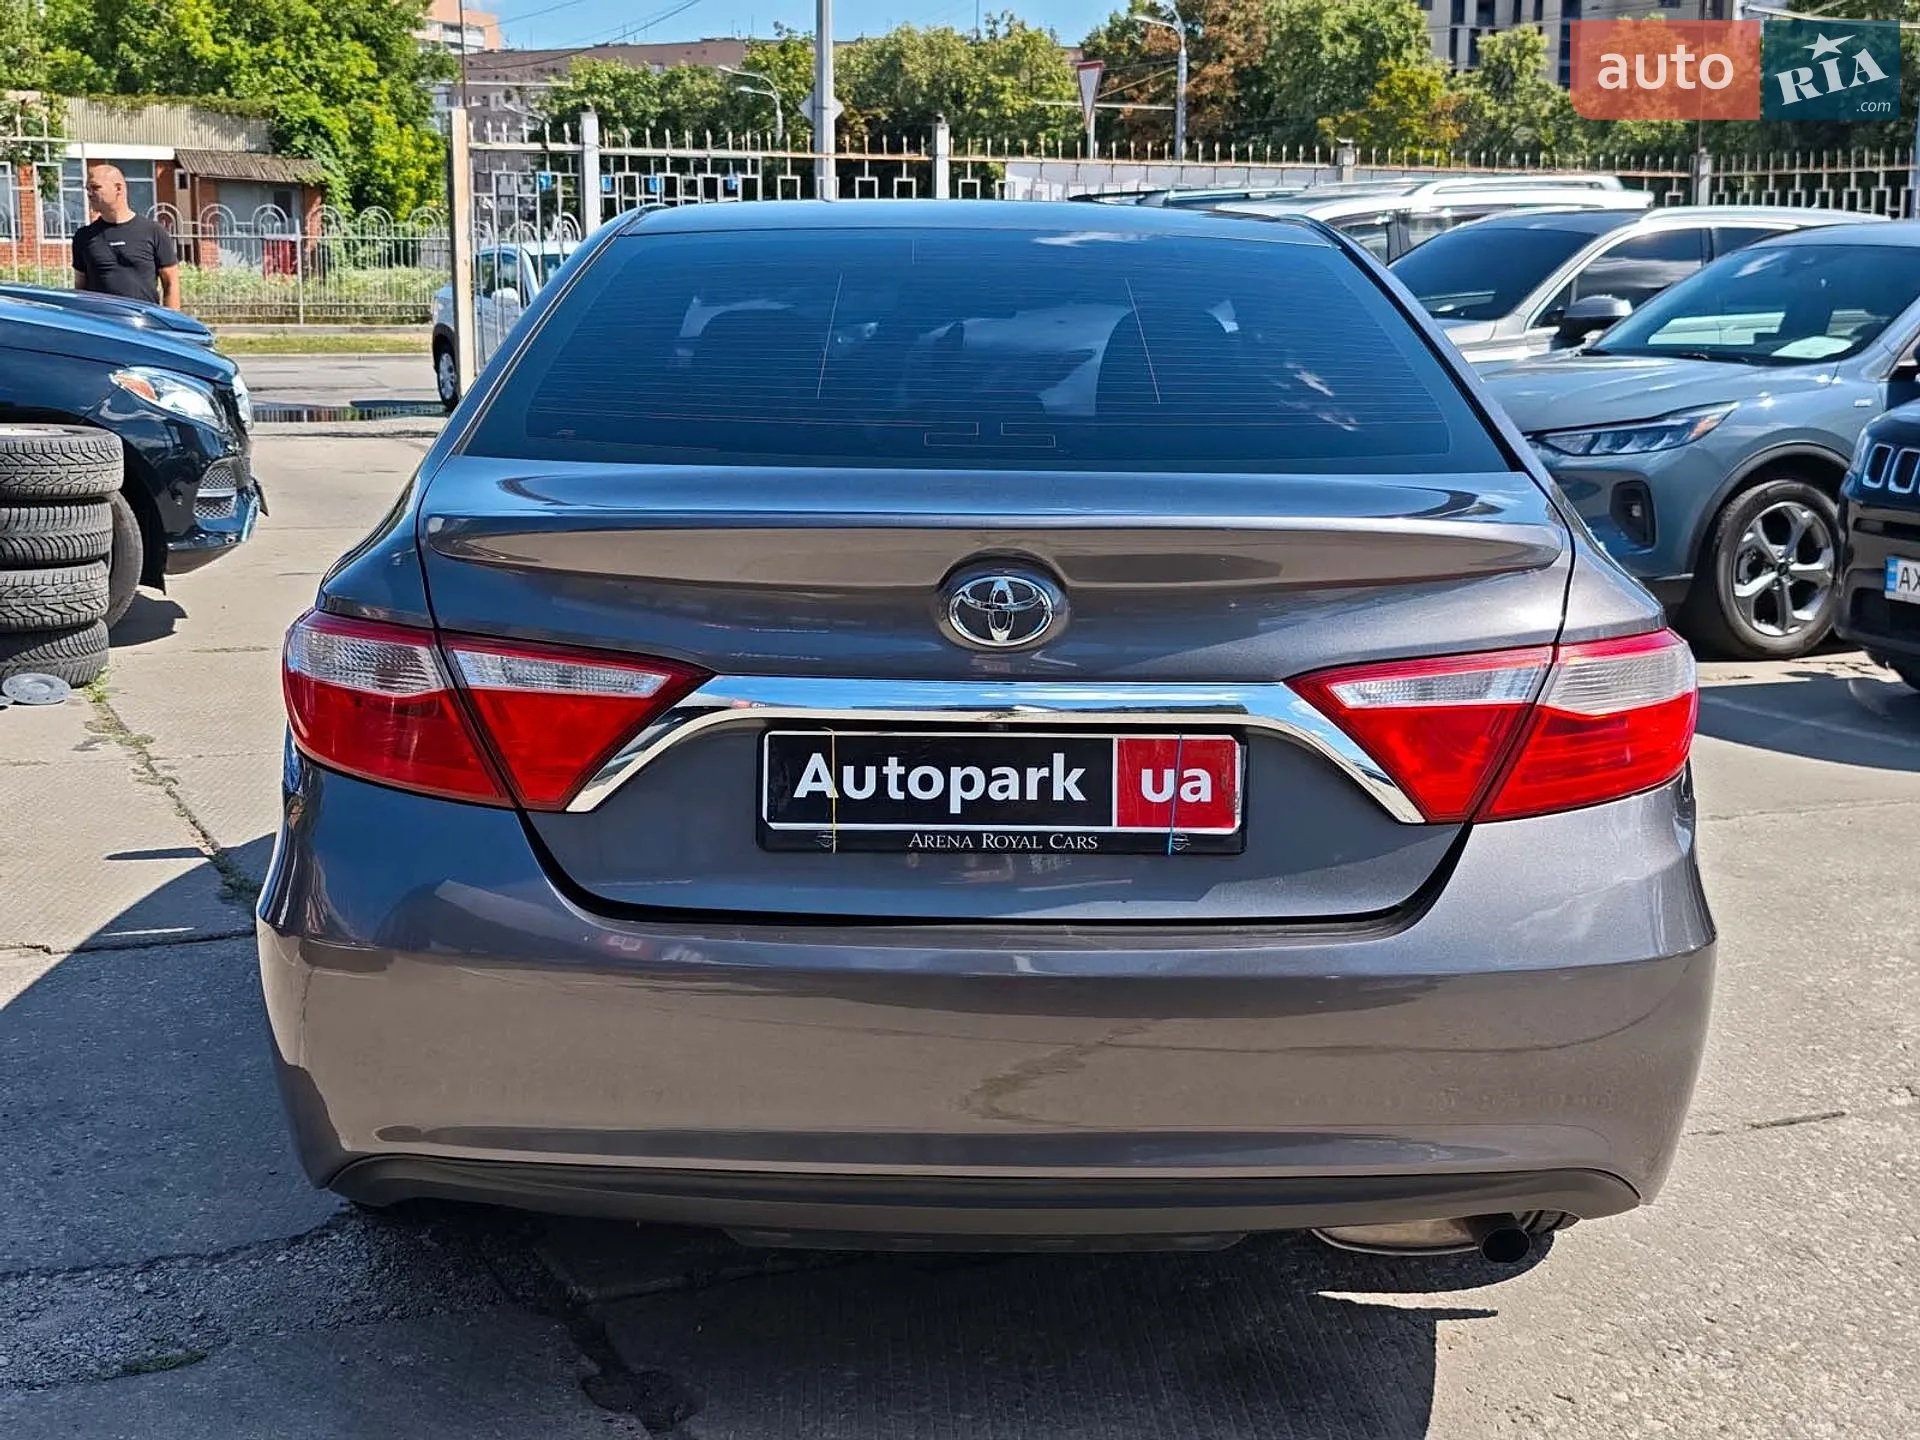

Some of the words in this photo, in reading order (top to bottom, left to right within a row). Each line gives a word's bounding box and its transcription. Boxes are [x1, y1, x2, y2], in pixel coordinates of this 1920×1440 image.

[793, 752, 1087, 814] Autopark
[1141, 767, 1212, 803] ua
[908, 832, 973, 849] ARENA
[982, 832, 1043, 849] ROYAL
[1049, 833, 1098, 850] CARS
